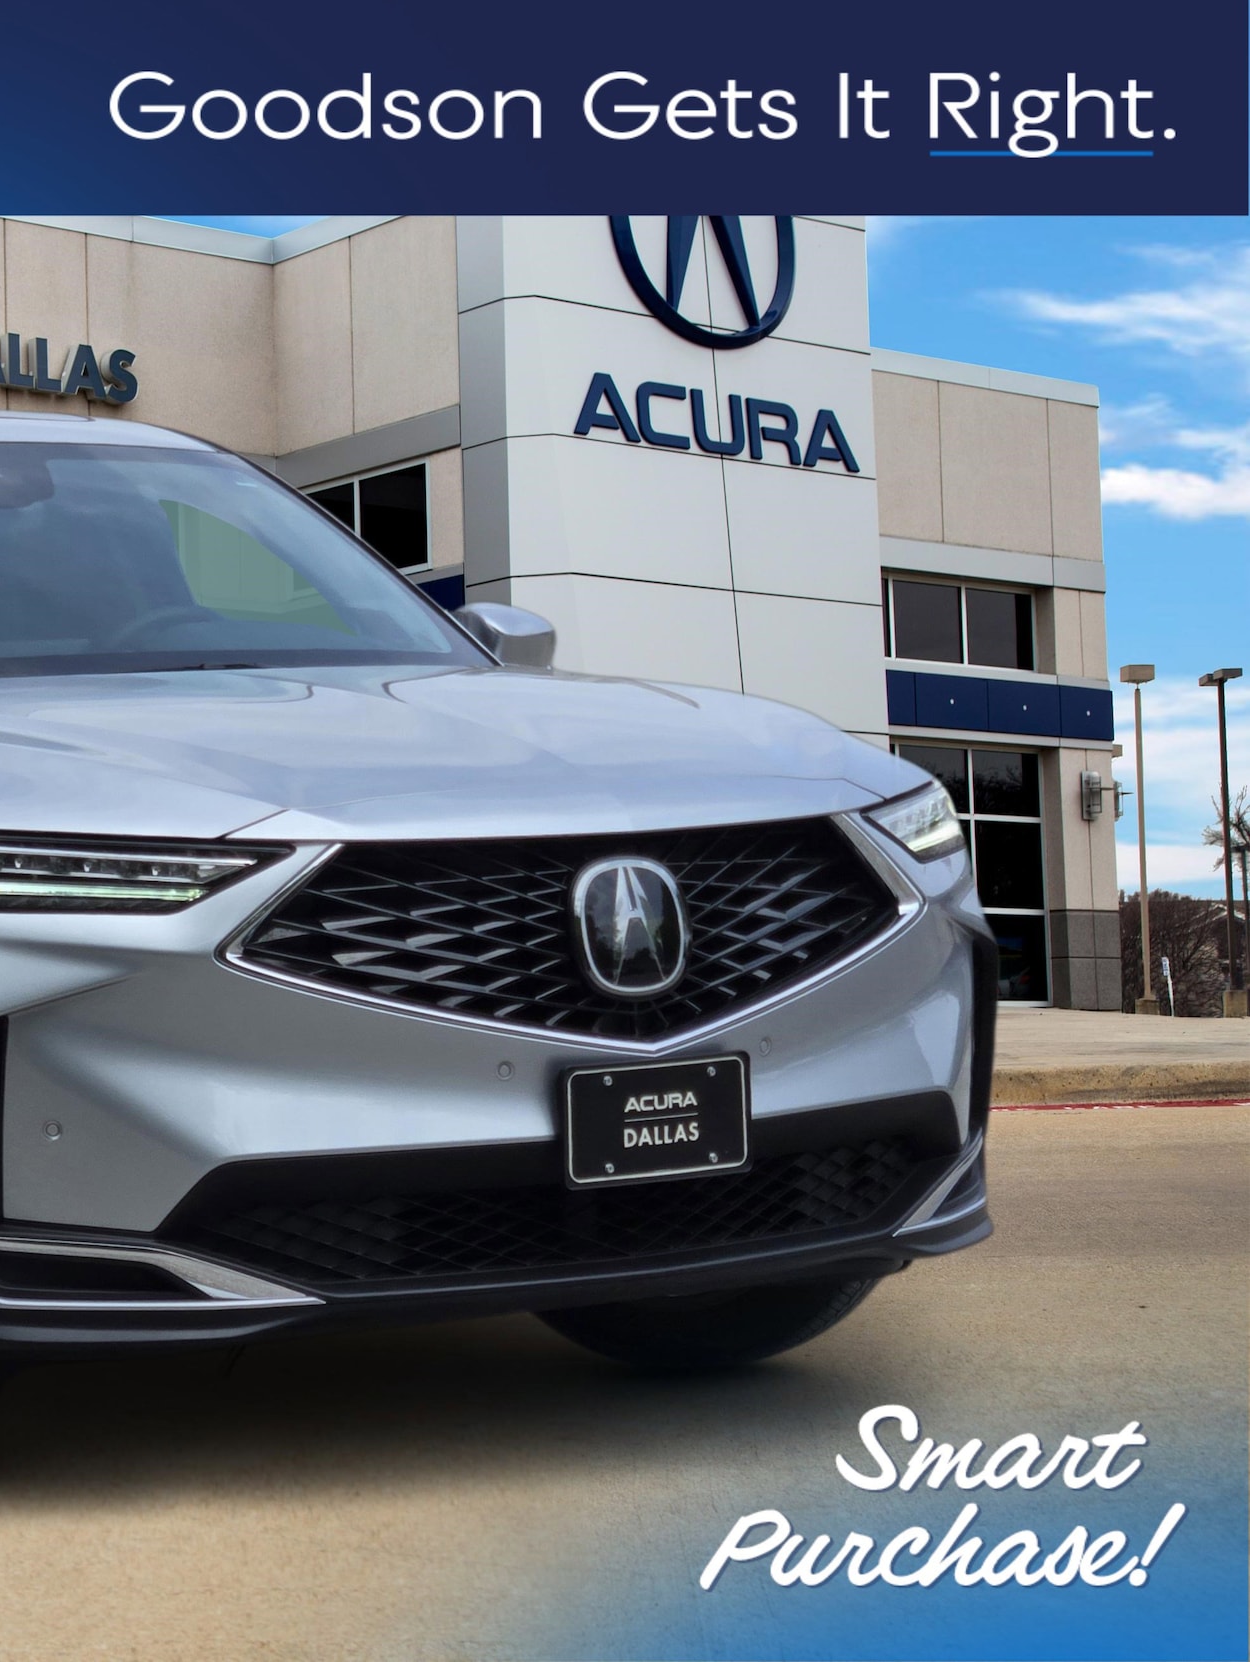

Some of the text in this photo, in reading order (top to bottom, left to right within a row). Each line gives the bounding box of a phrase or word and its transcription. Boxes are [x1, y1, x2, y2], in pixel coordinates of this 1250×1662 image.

[574, 372, 860, 474] ACURA
[624, 1091, 698, 1113] ACURA
[623, 1122, 700, 1148] DALLAS
